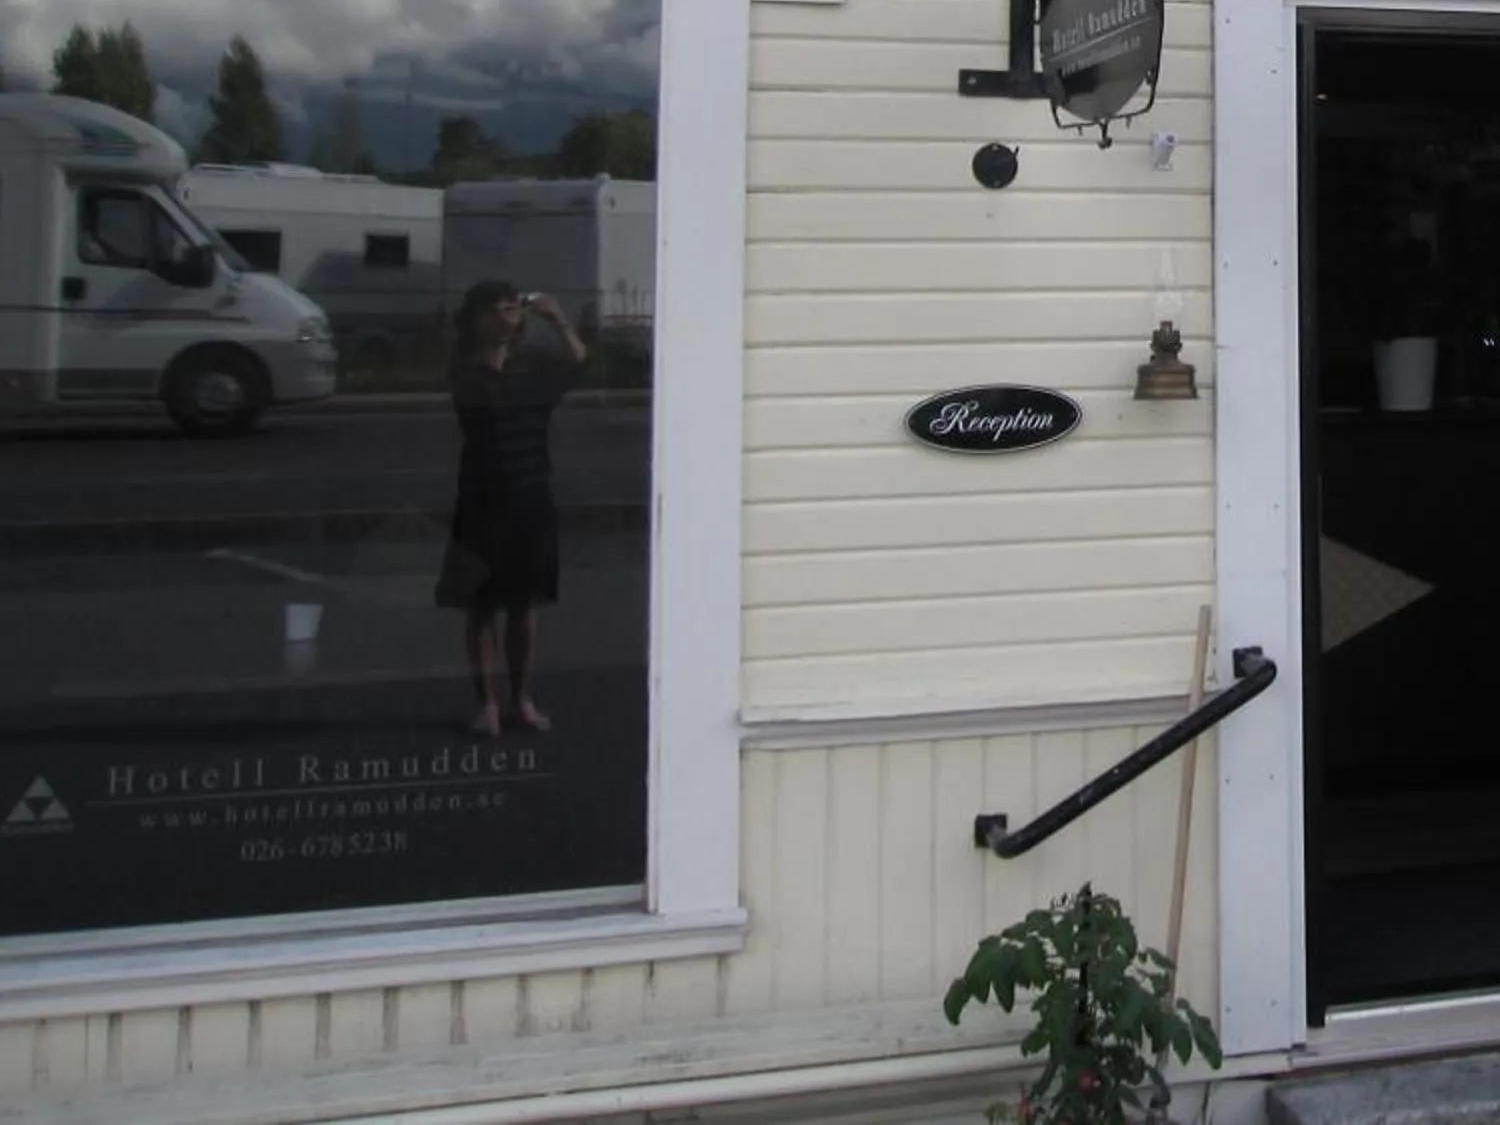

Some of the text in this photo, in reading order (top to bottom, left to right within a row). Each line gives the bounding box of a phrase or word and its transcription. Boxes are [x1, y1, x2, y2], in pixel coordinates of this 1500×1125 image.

[929, 400, 1053, 442] Reception
[108, 745, 538, 797] Hotell Ramudden
